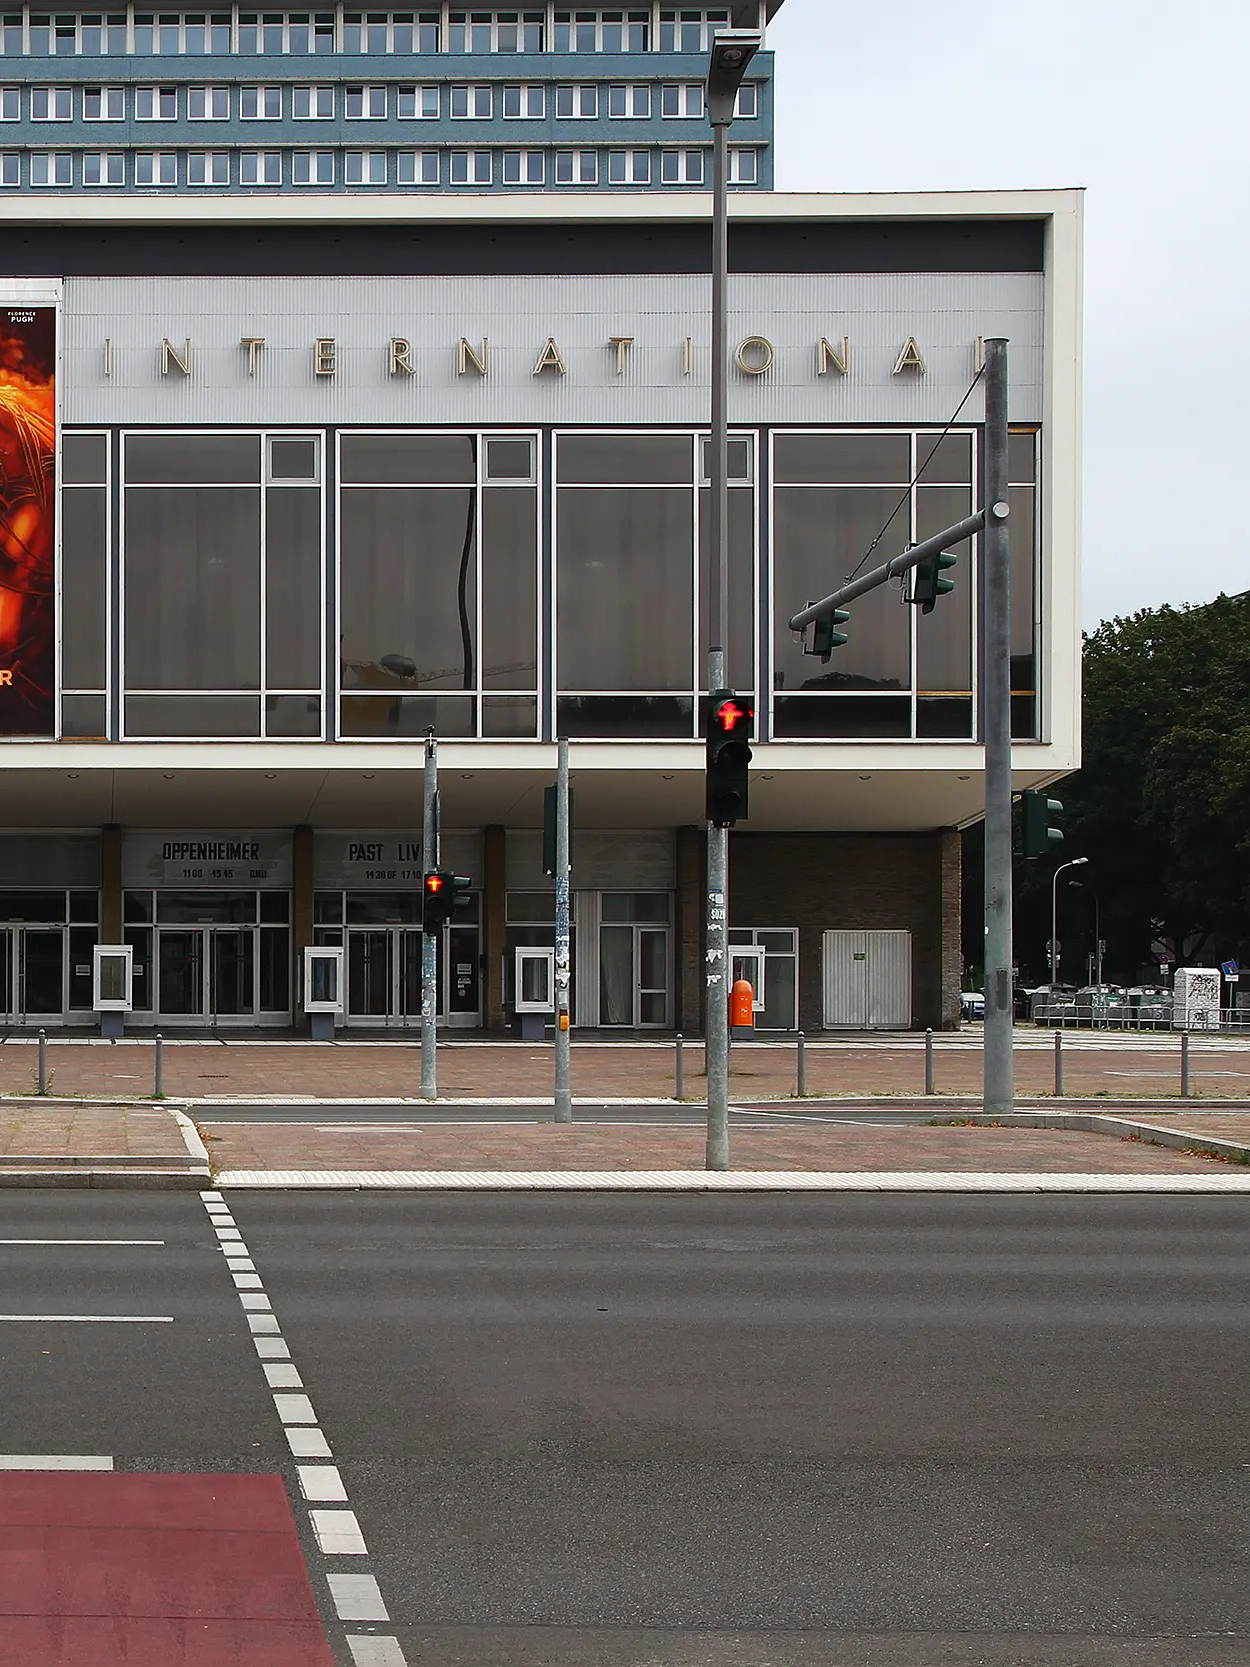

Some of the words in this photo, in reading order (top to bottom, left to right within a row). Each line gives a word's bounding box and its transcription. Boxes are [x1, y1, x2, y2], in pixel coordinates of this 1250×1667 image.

[162, 842, 260, 861] OPPENHEIMER
[349, 843, 384, 862] PAST
[397, 843, 422, 862] LIV
